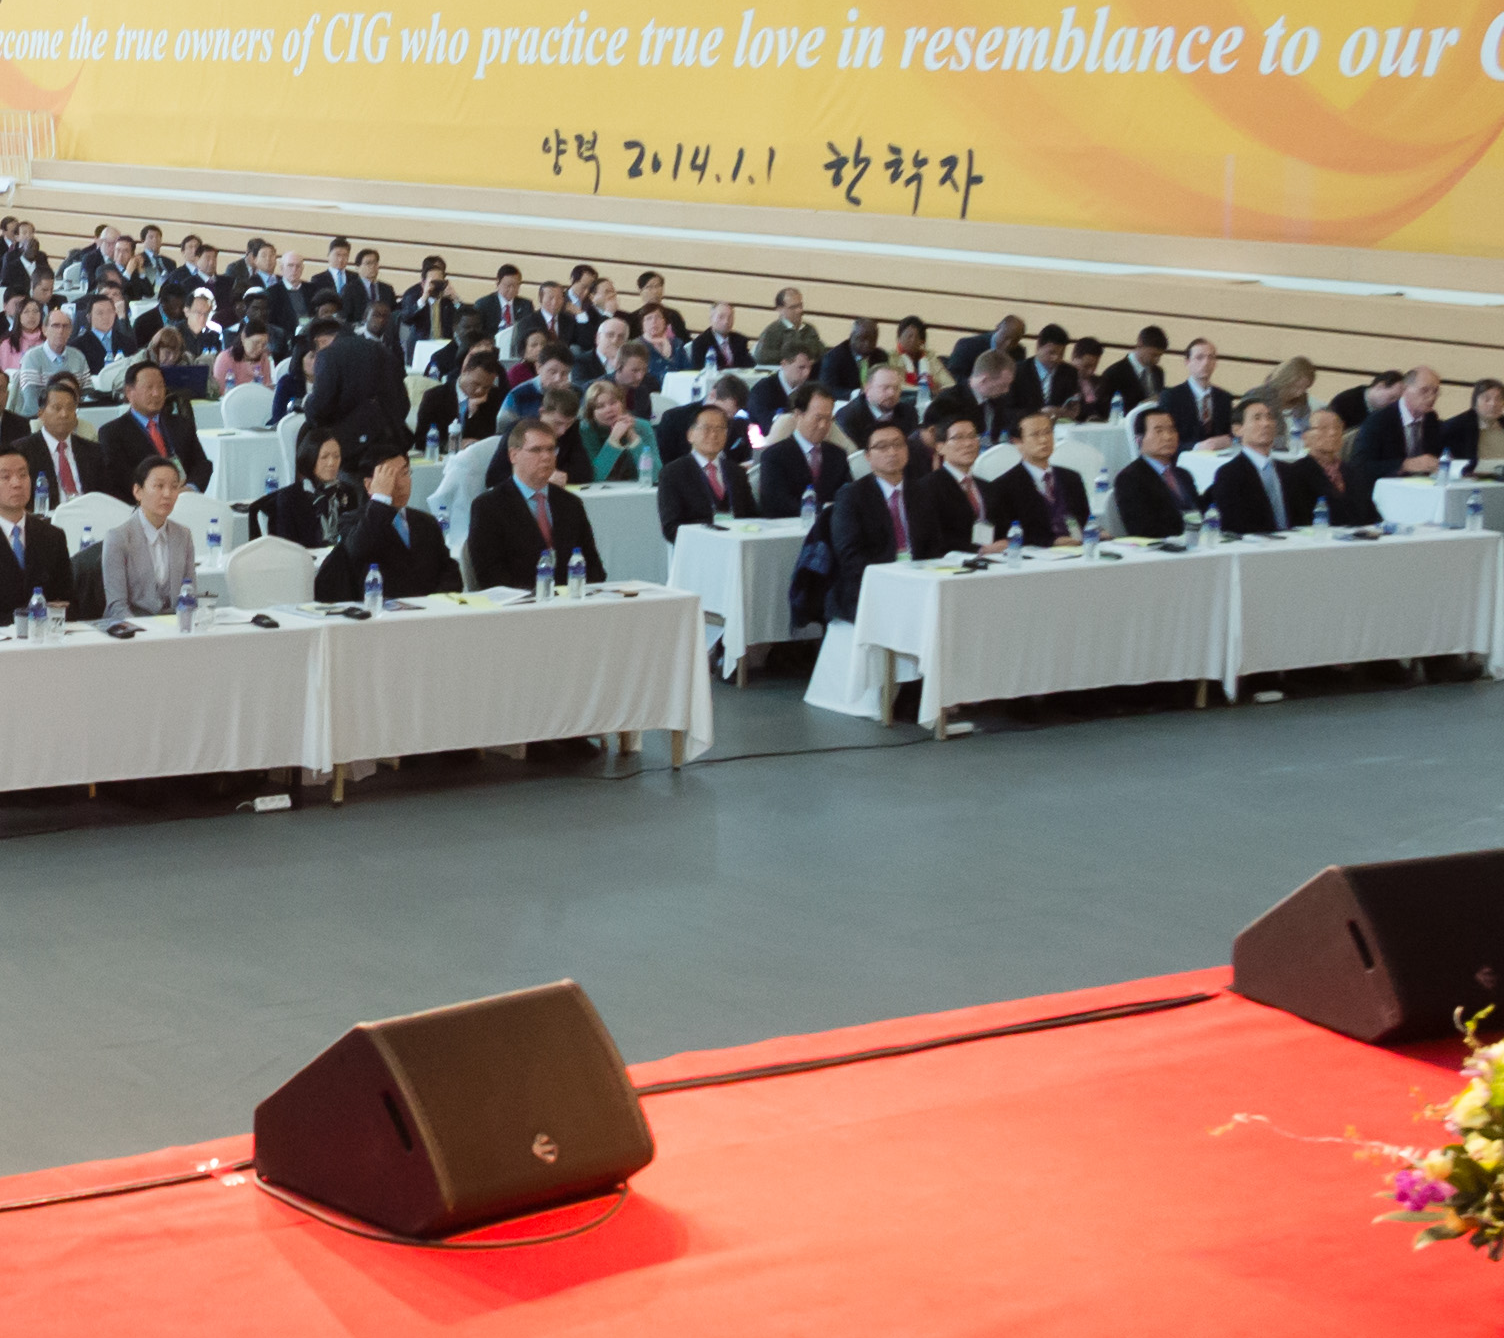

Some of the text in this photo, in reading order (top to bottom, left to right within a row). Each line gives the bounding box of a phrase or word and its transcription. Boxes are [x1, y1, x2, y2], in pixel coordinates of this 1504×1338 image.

[68, 16, 108, 62] the
[113, 21, 168, 62] true
[174, 27, 275, 64] owners
[281, 13, 320, 76] of
[323, 12, 393, 65] CIG
[400, 13, 469, 67] who
[473, 9, 629, 80] practice
[638, 17, 725, 68] true
[733, 9, 823, 70] love
[836, 7, 885, 70] in
[899, 5, 1243, 76] resemblance
[1260, 13, 1321, 76] to
[1338, 20, 1461, 78] our
[541, 129, 984, 219] 양력 2014.1.1 한학자
